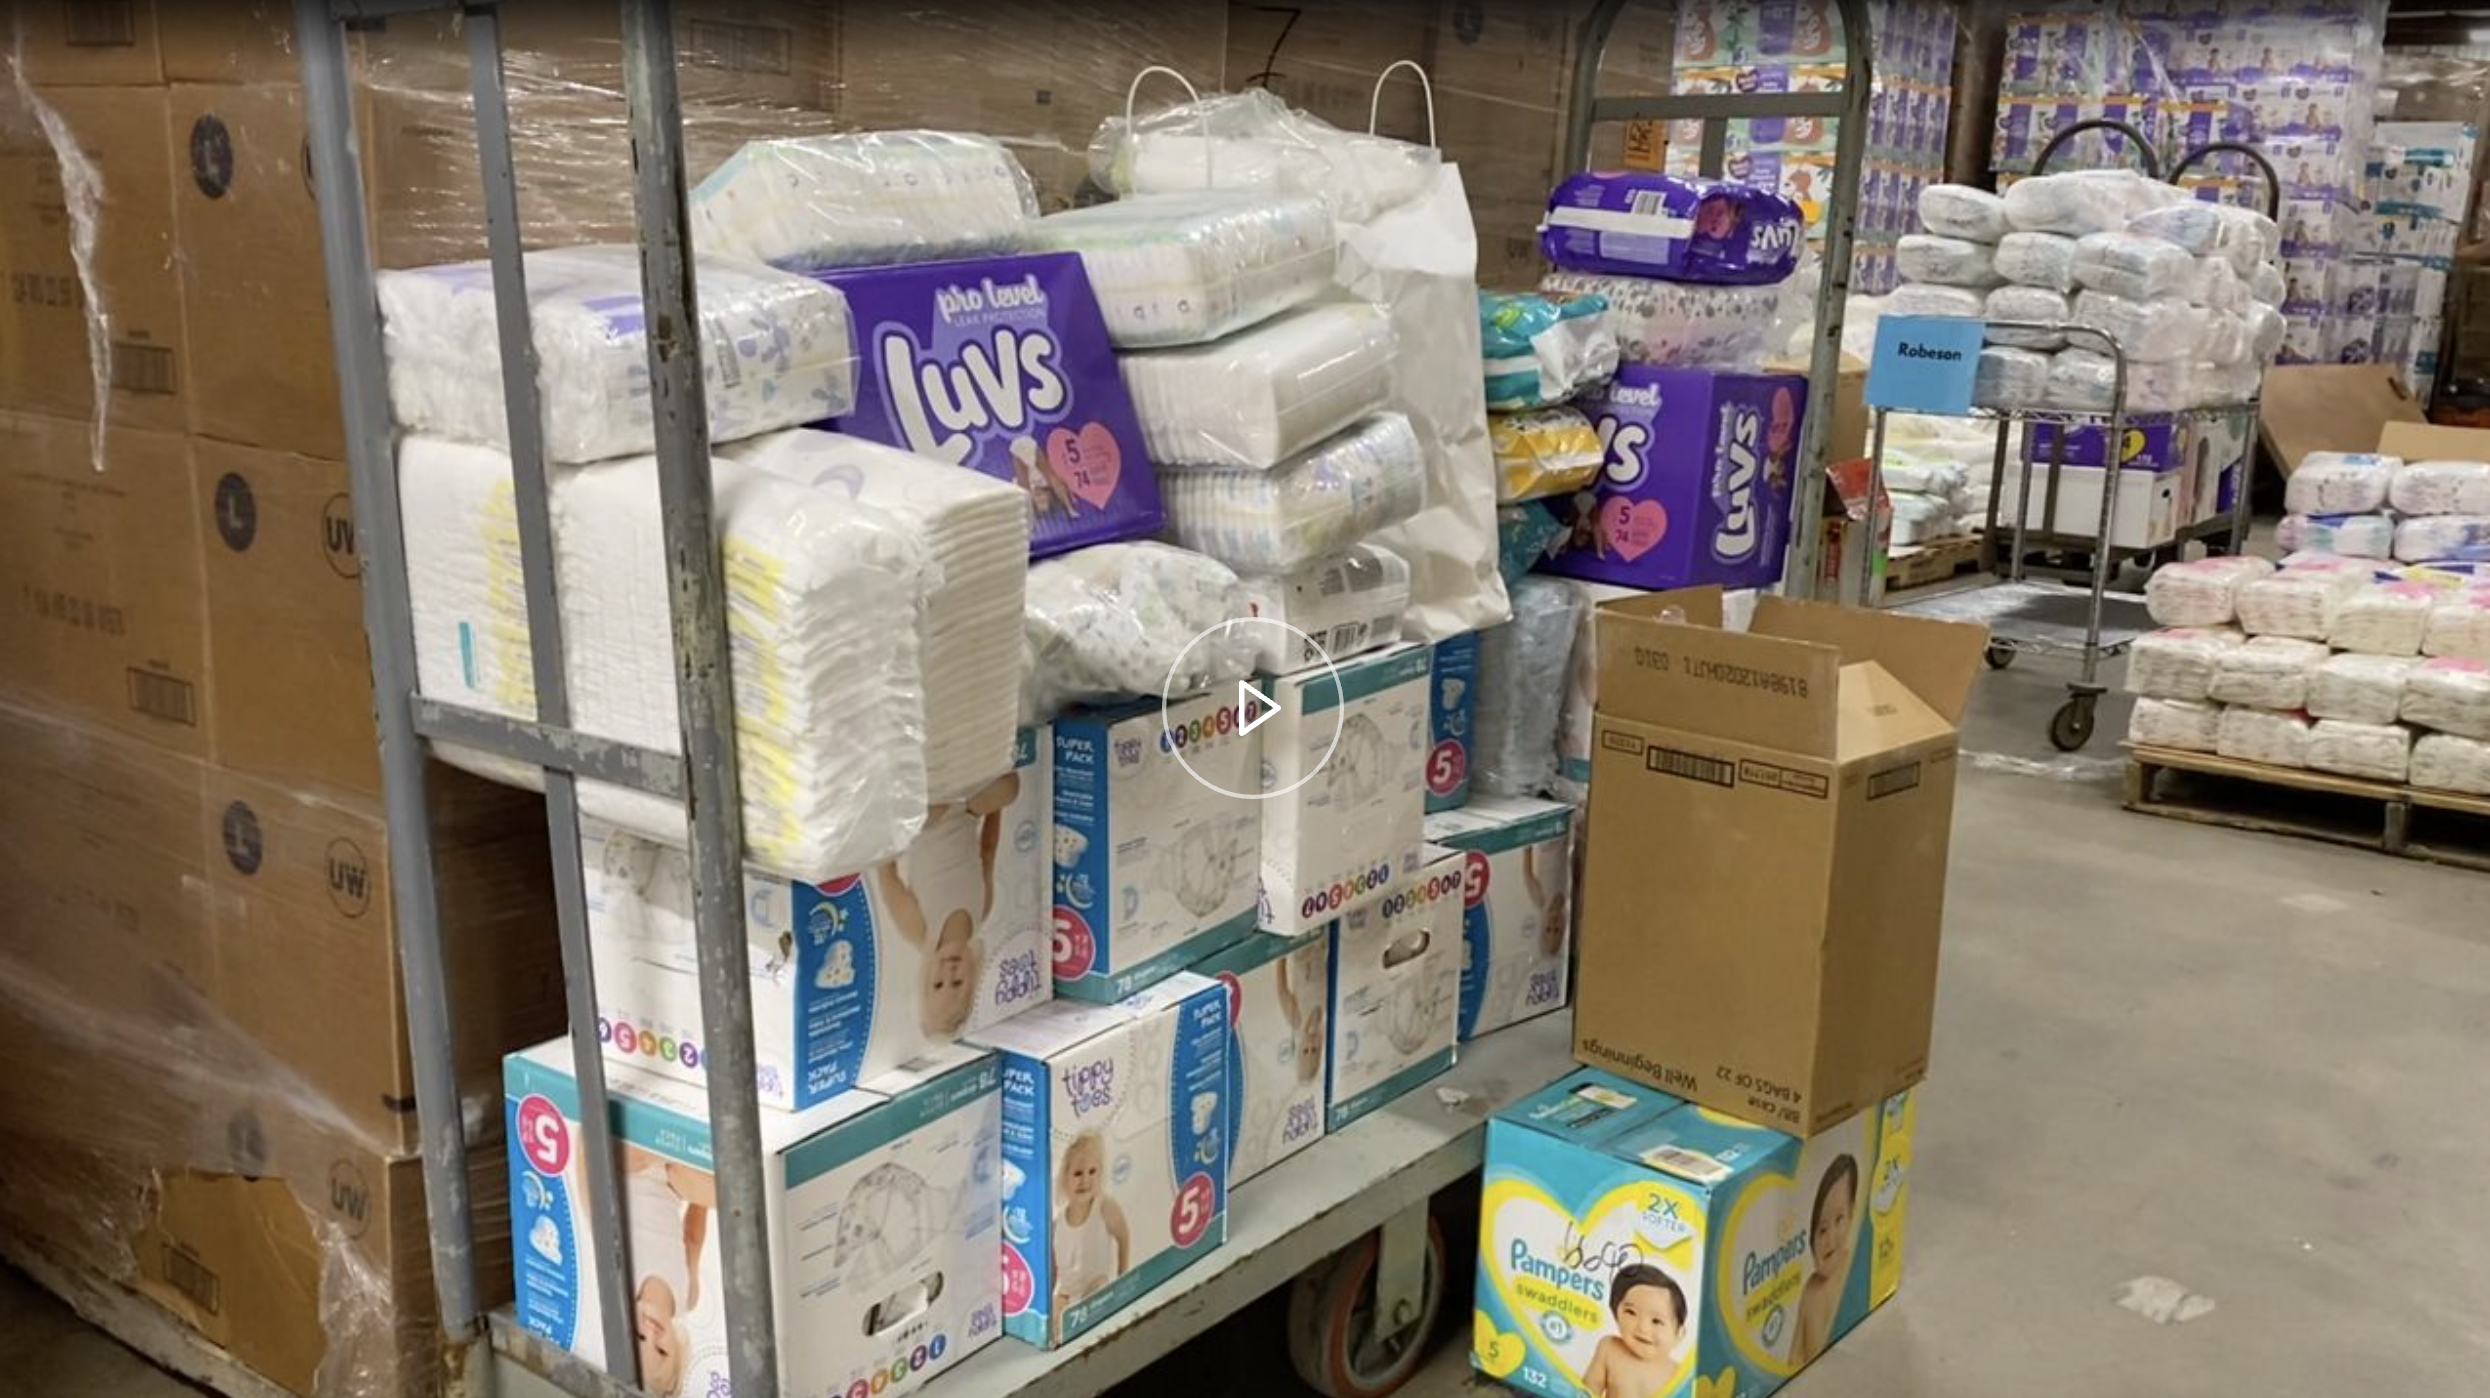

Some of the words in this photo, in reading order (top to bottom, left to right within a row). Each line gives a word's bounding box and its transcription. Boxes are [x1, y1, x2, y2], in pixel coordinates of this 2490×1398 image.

[935, 286, 983, 324] pro
[981, 273, 1044, 309] level
[1897, 341, 1962, 363] Robeson
[1063, 438, 1082, 465] 5
[1073, 470, 1092, 489] 74
[1712, 411, 1759, 560] Luvs
[1618, 506, 1631, 526] 5
[1056, 735, 1095, 753] SUPER
[1433, 750, 1453, 784] 5
[329, 861, 366, 901] UW
[1465, 861, 1484, 898] 5
[1582, 1038, 1663, 1082] Beginnings
[1715, 1065, 1732, 1081] 22
[808, 1070, 847, 1095] SUPER
[1062, 1056, 1115, 1099] tippy
[1664, 1069, 1698, 1093] Well
[1736, 1073, 1752, 1088] OF
[1755, 1078, 1793, 1101] BAGS
[534, 1113, 560, 1164] 5
[331, 1182, 370, 1223] UW
[1179, 1186, 1200, 1234] 5
[1647, 1193, 1679, 1220] 2X
[1509, 1238, 1605, 1302] Pampers
[1743, 1228, 1807, 1296] Pampers
[1515, 1282, 1599, 1325] swaddlers
[1522, 1365, 1547, 1387] 132
